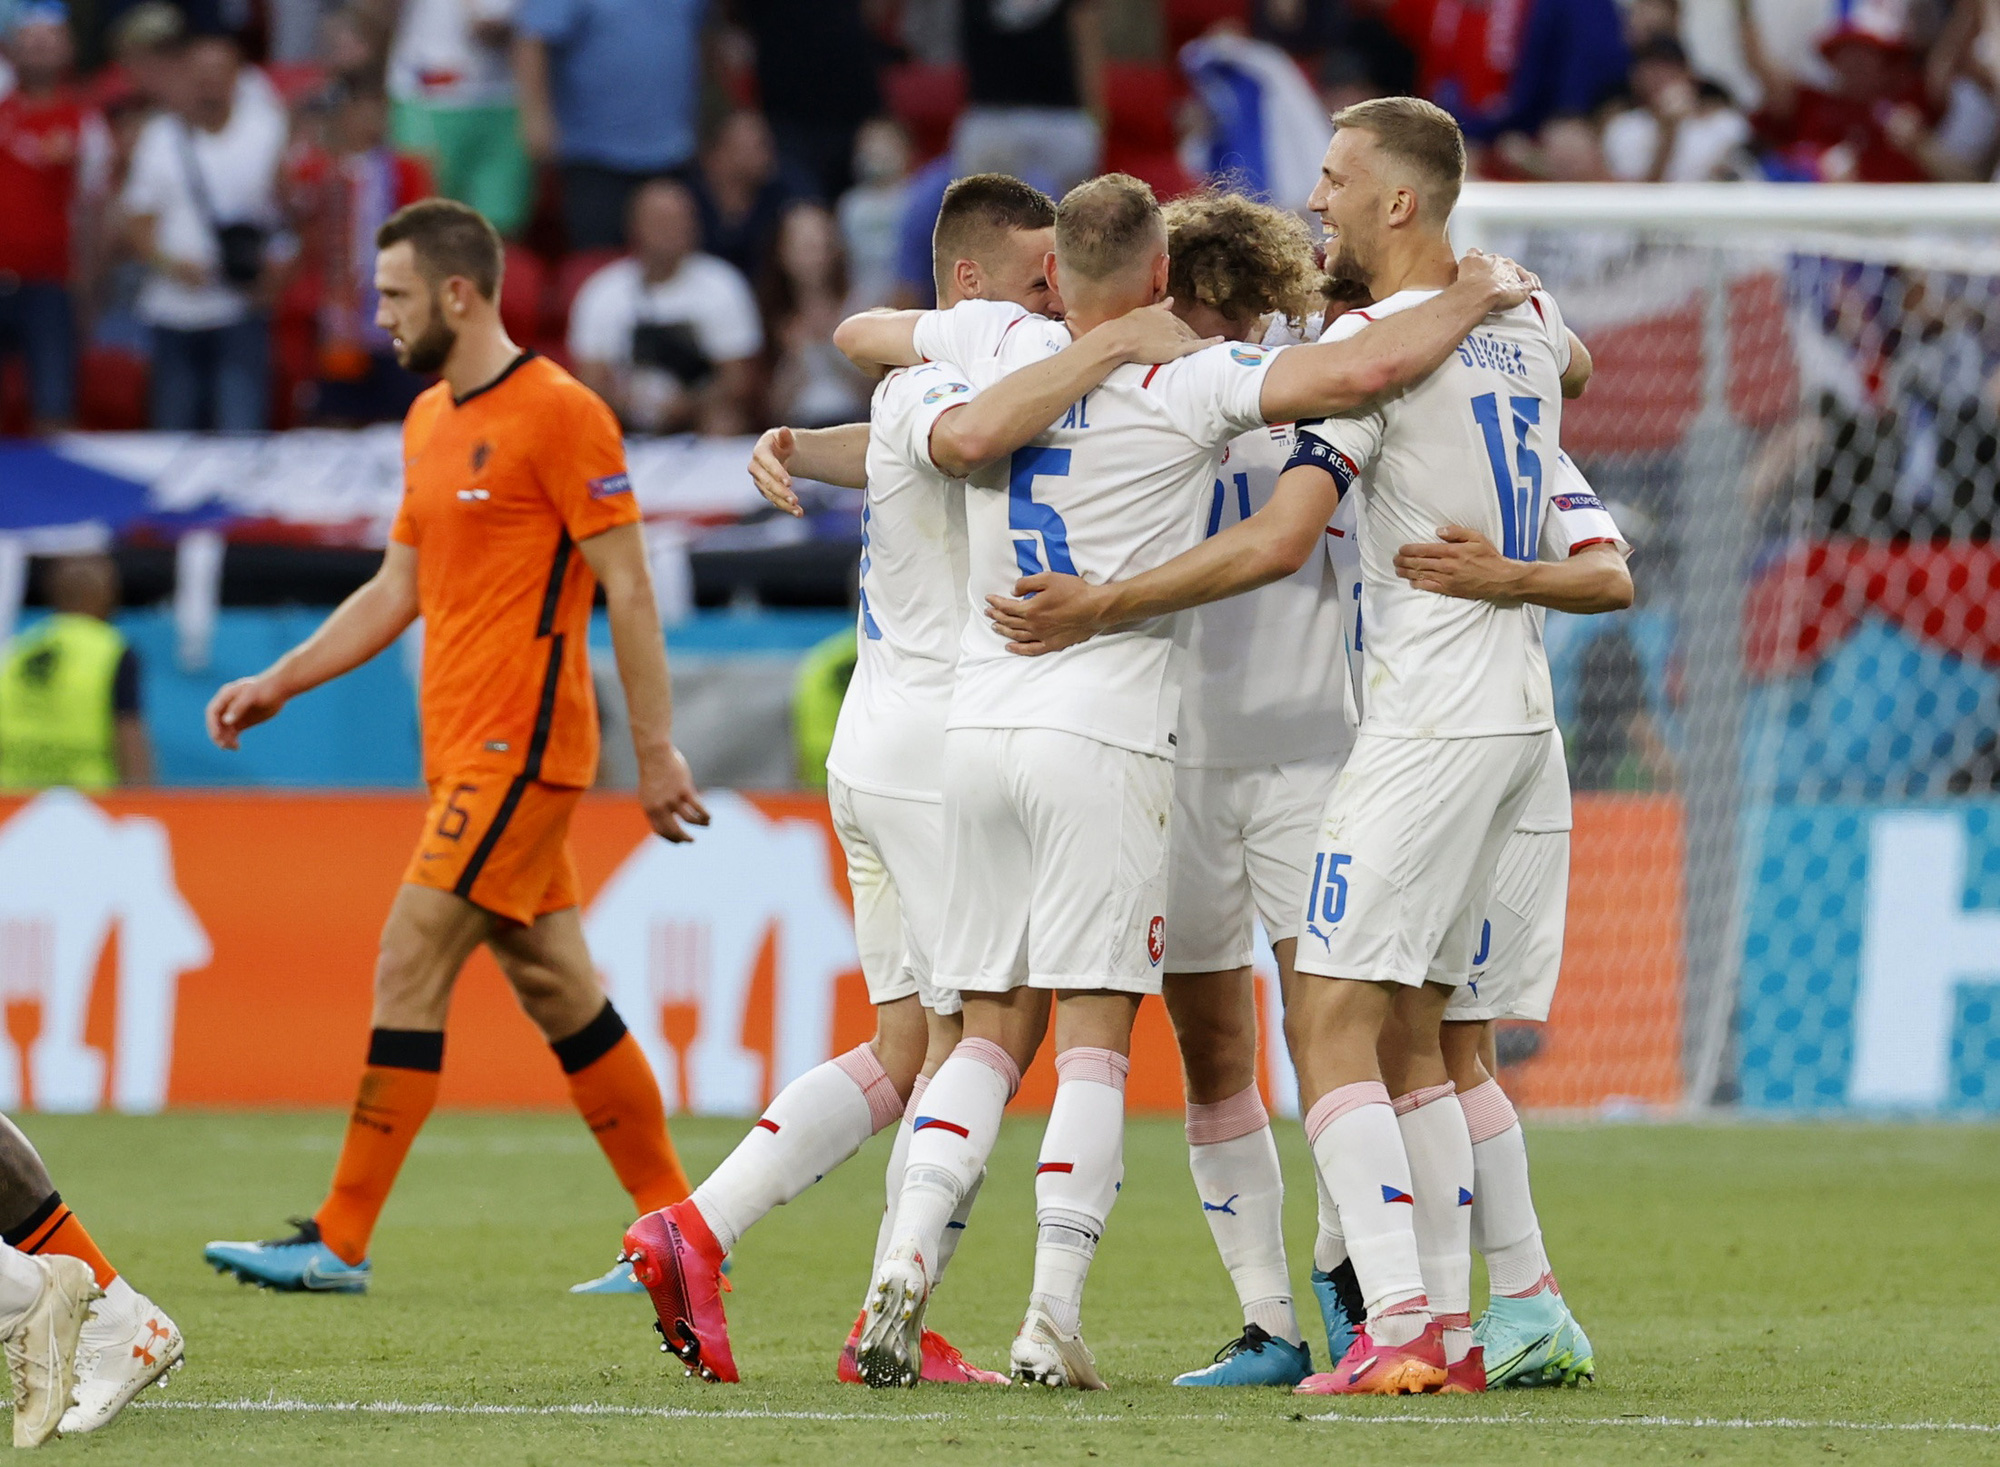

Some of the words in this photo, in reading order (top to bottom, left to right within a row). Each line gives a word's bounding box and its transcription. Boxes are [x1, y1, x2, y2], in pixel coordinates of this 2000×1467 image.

[1061, 393, 1090, 429] AL
[1471, 392, 1542, 562] 15
[1009, 446, 1080, 601] 5
[437, 783, 478, 841] 6
[1307, 853, 1352, 923] 15
